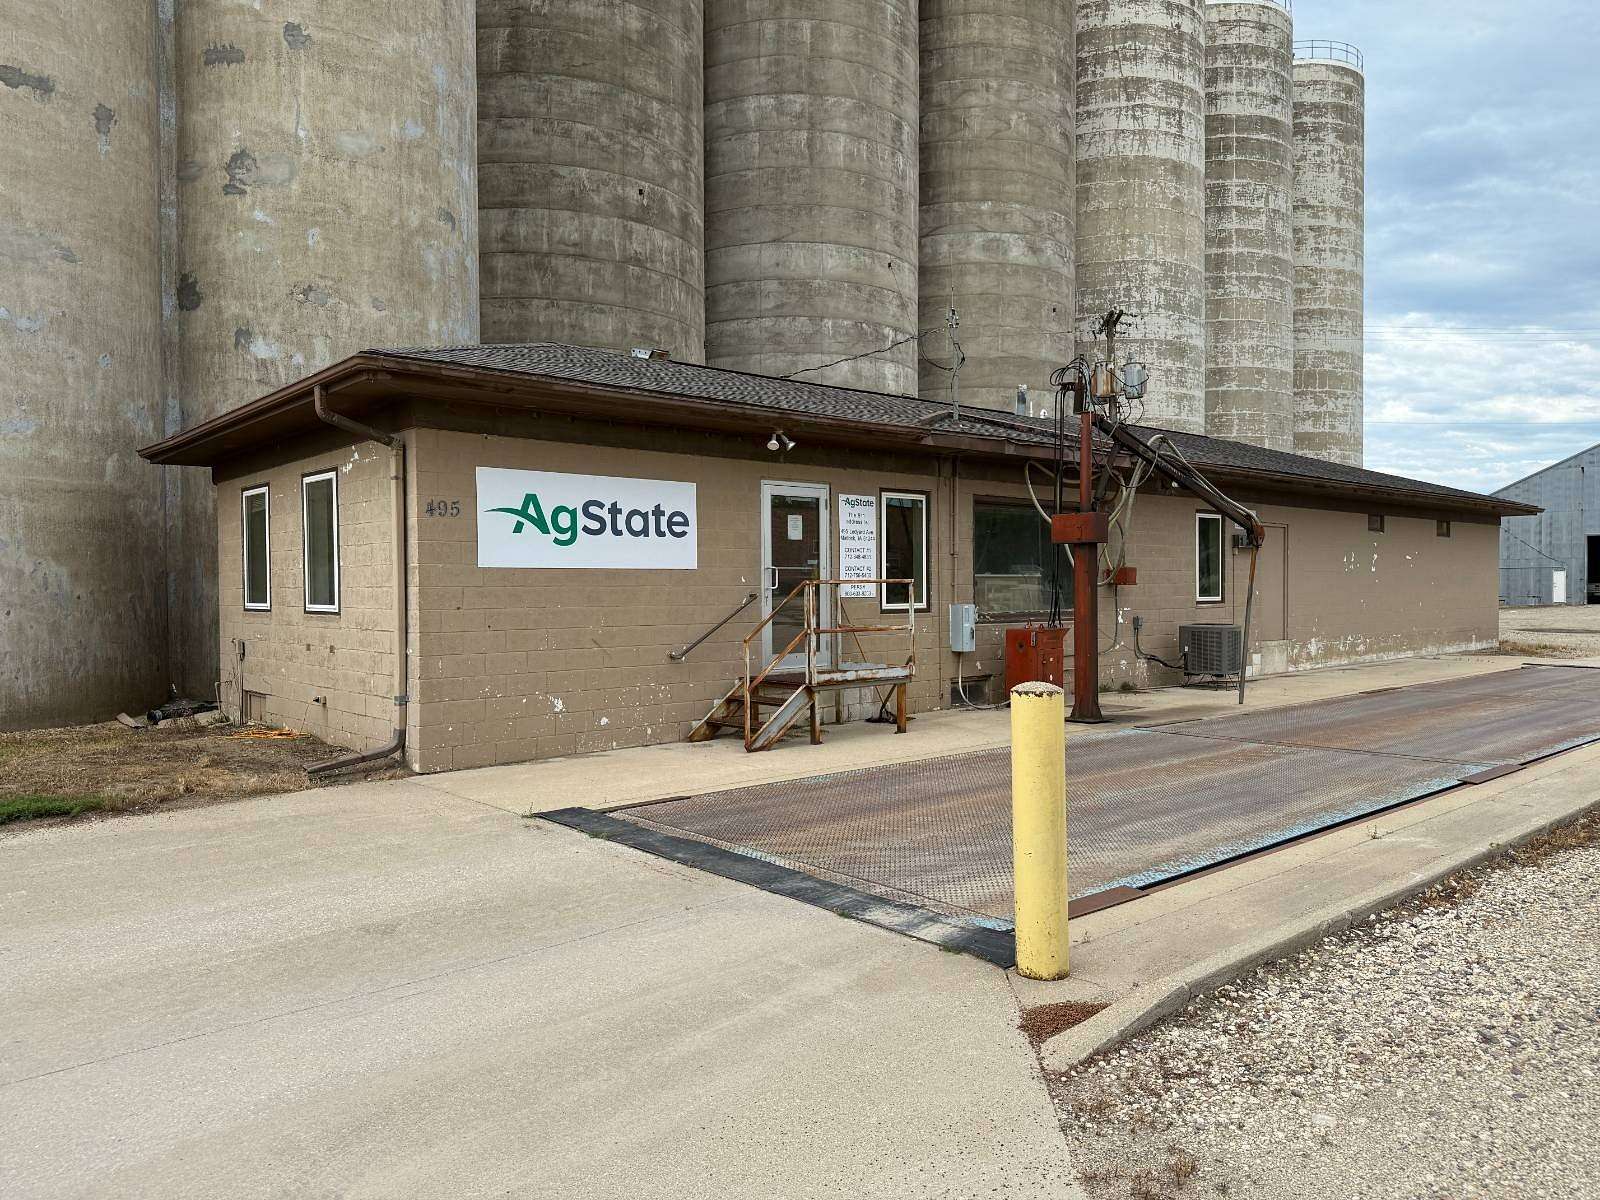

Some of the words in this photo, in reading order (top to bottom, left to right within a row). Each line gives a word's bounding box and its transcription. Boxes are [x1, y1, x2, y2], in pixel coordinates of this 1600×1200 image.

[425, 499, 461, 517] 495
[841, 497, 874, 508] AgState
[484, 493, 690, 547] AgState
